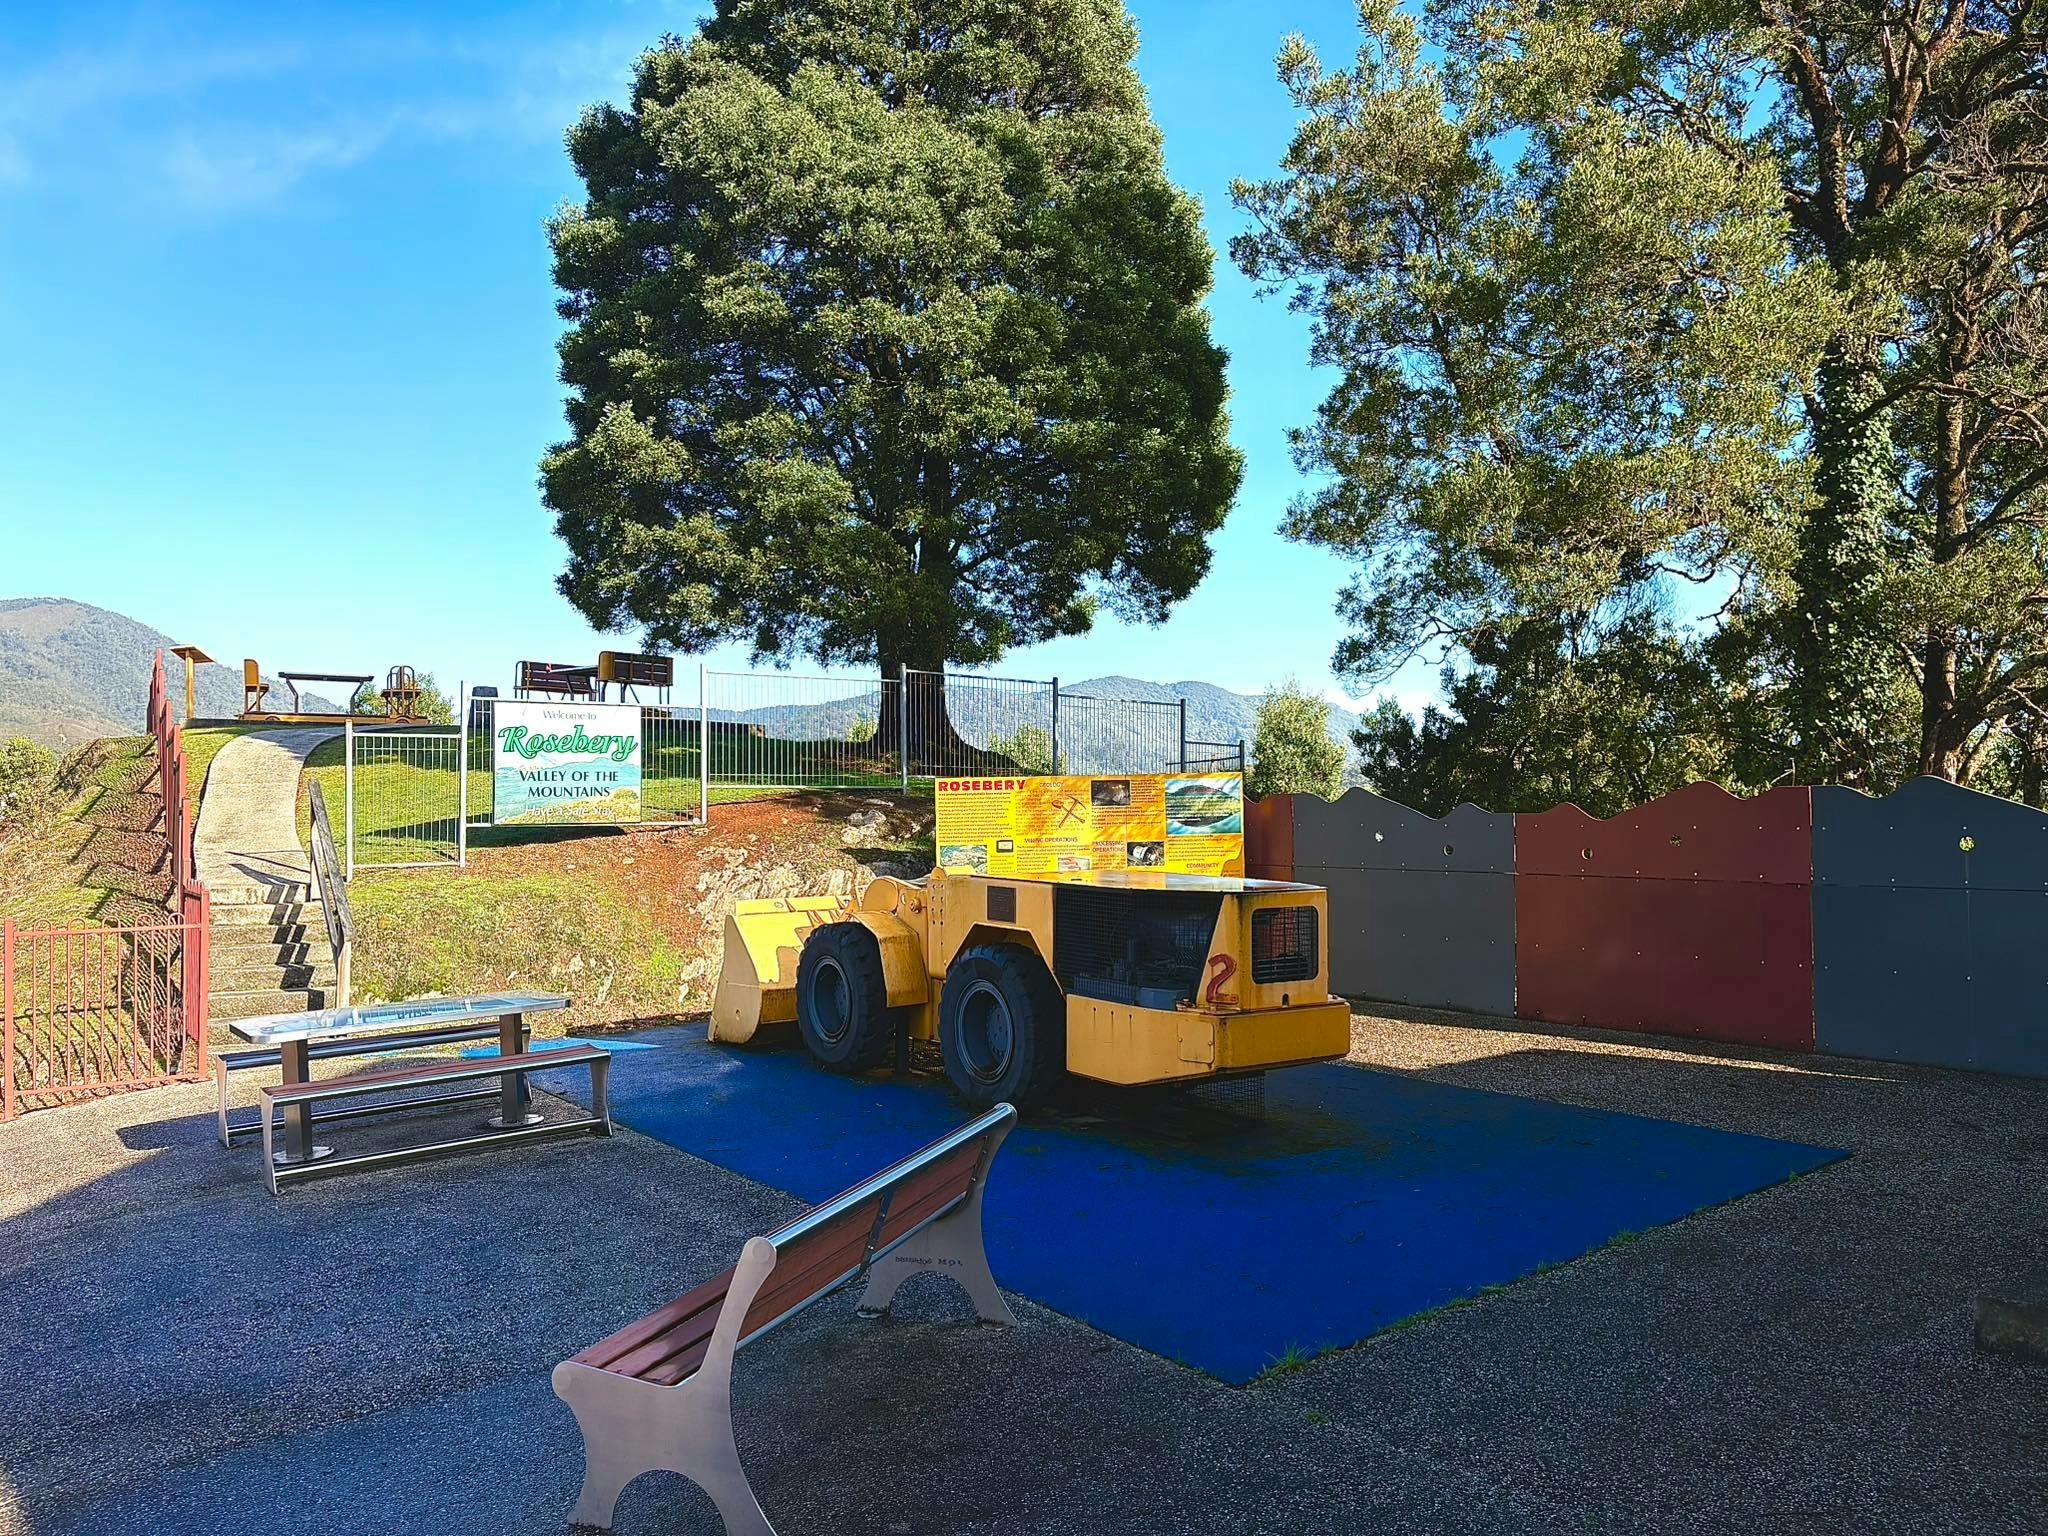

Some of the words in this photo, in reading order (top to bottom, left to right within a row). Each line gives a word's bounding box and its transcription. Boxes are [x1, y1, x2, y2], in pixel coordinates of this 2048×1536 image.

[543, 710, 586, 720] Welcome
[587, 711, 597, 720] to
[498, 724, 639, 762] Rosebery
[520, 770, 566, 782] VALLEY
[571, 770, 590, 782] OF
[595, 771, 619, 782] THE
[938, 780, 1026, 791] ROSEBERY
[528, 786, 610, 798] MOUNTAINS
[525, 805, 554, 817] Have
[556, 807, 563, 816] a
[566, 806, 588, 817] Safe
[1207, 954, 1239, 1005] 2
